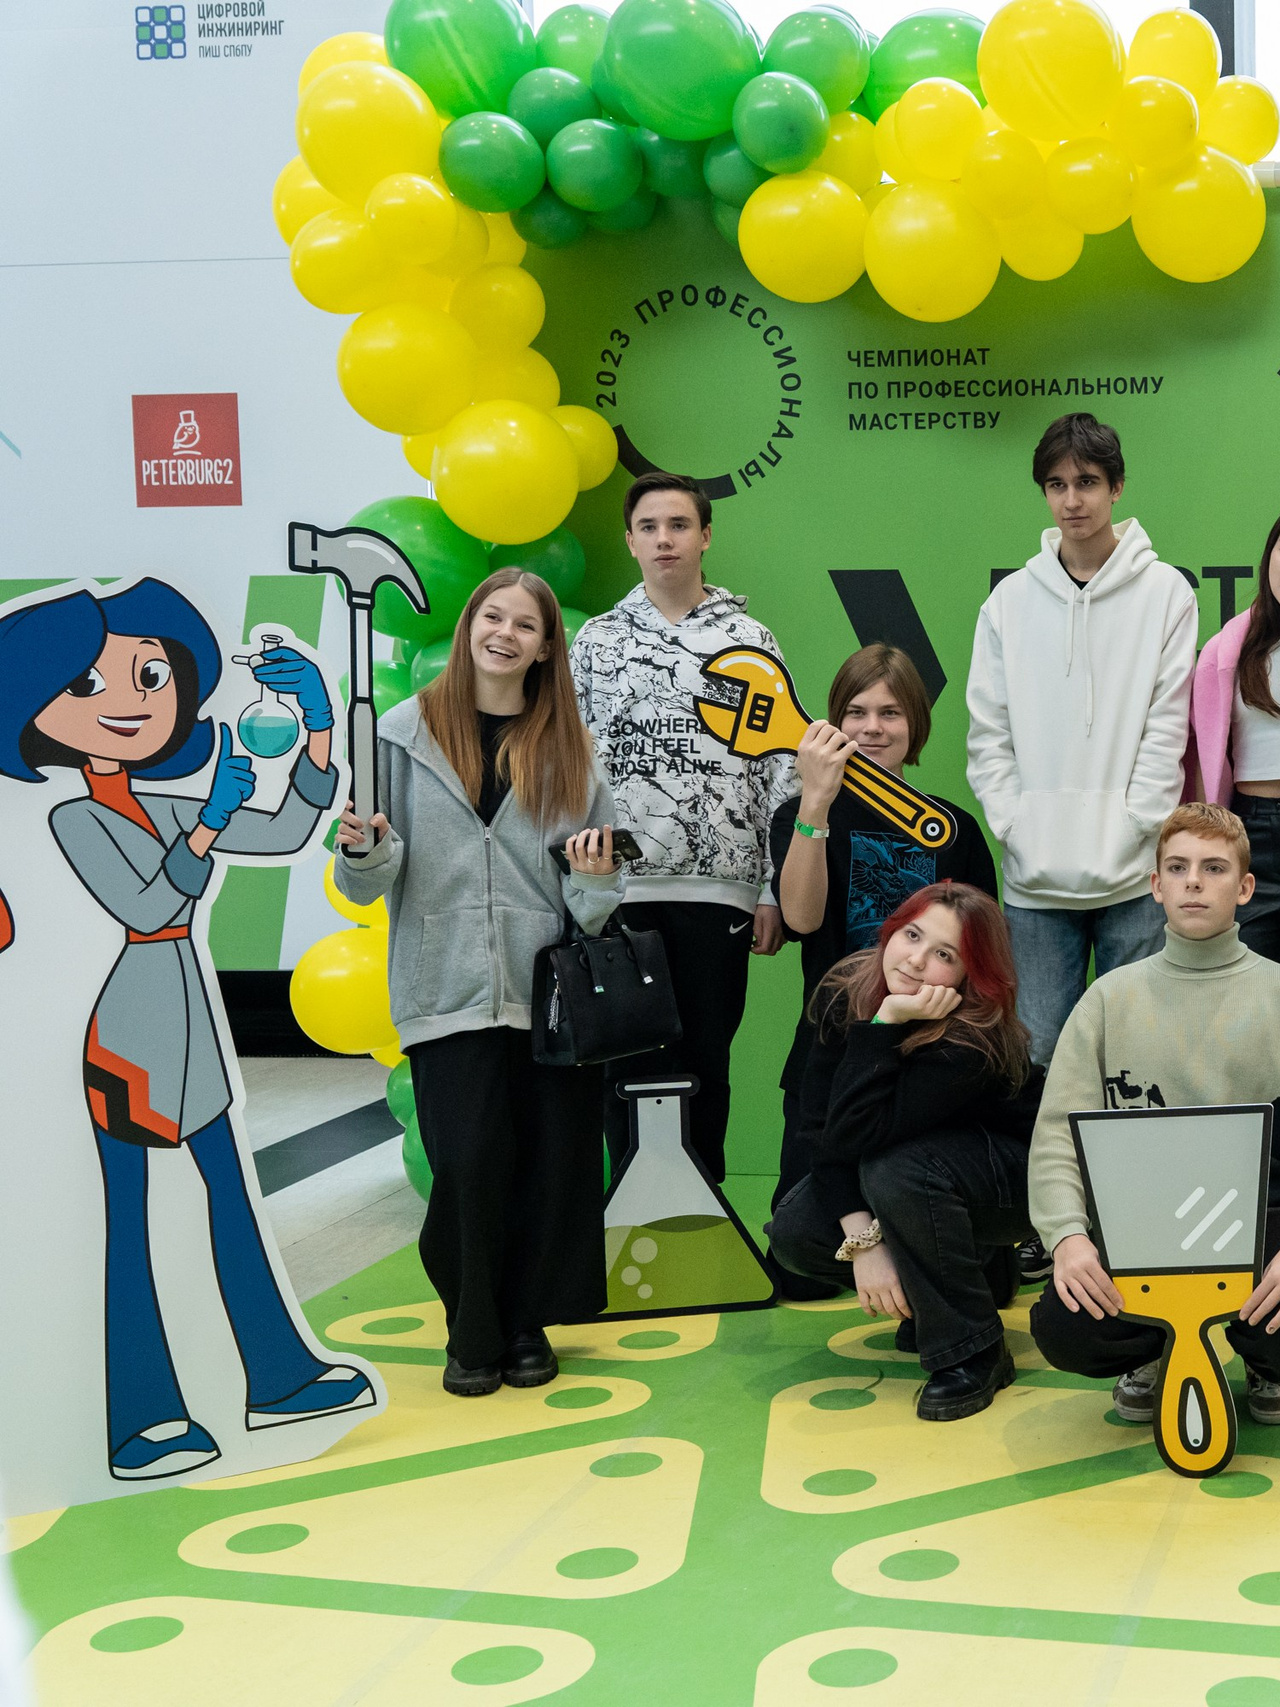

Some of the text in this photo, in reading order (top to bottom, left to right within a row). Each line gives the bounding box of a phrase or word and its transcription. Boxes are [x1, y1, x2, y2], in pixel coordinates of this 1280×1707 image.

[197, 0, 265, 21] ЦИФРОВОЙ
[198, 20, 284, 38] ИНЖИНИРИНГ
[199, 45, 220, 58] ПИШ
[847, 348, 991, 368] ЧЕМПИОНАТ
[595, 284, 802, 488] 2023 ПРОФЕССИОНАЛЫ
[848, 376, 1165, 399] ПО ПРОФЕССИОНАЛЬНОМУ
[848, 411, 1001, 431] МАСТЕРСТВУ
[142, 458, 234, 486] PETERBURG2
[608, 721, 635, 738] GO
[608, 738, 701, 758] YOU FEEL
[610, 759, 722, 778] MOST ALIVE
